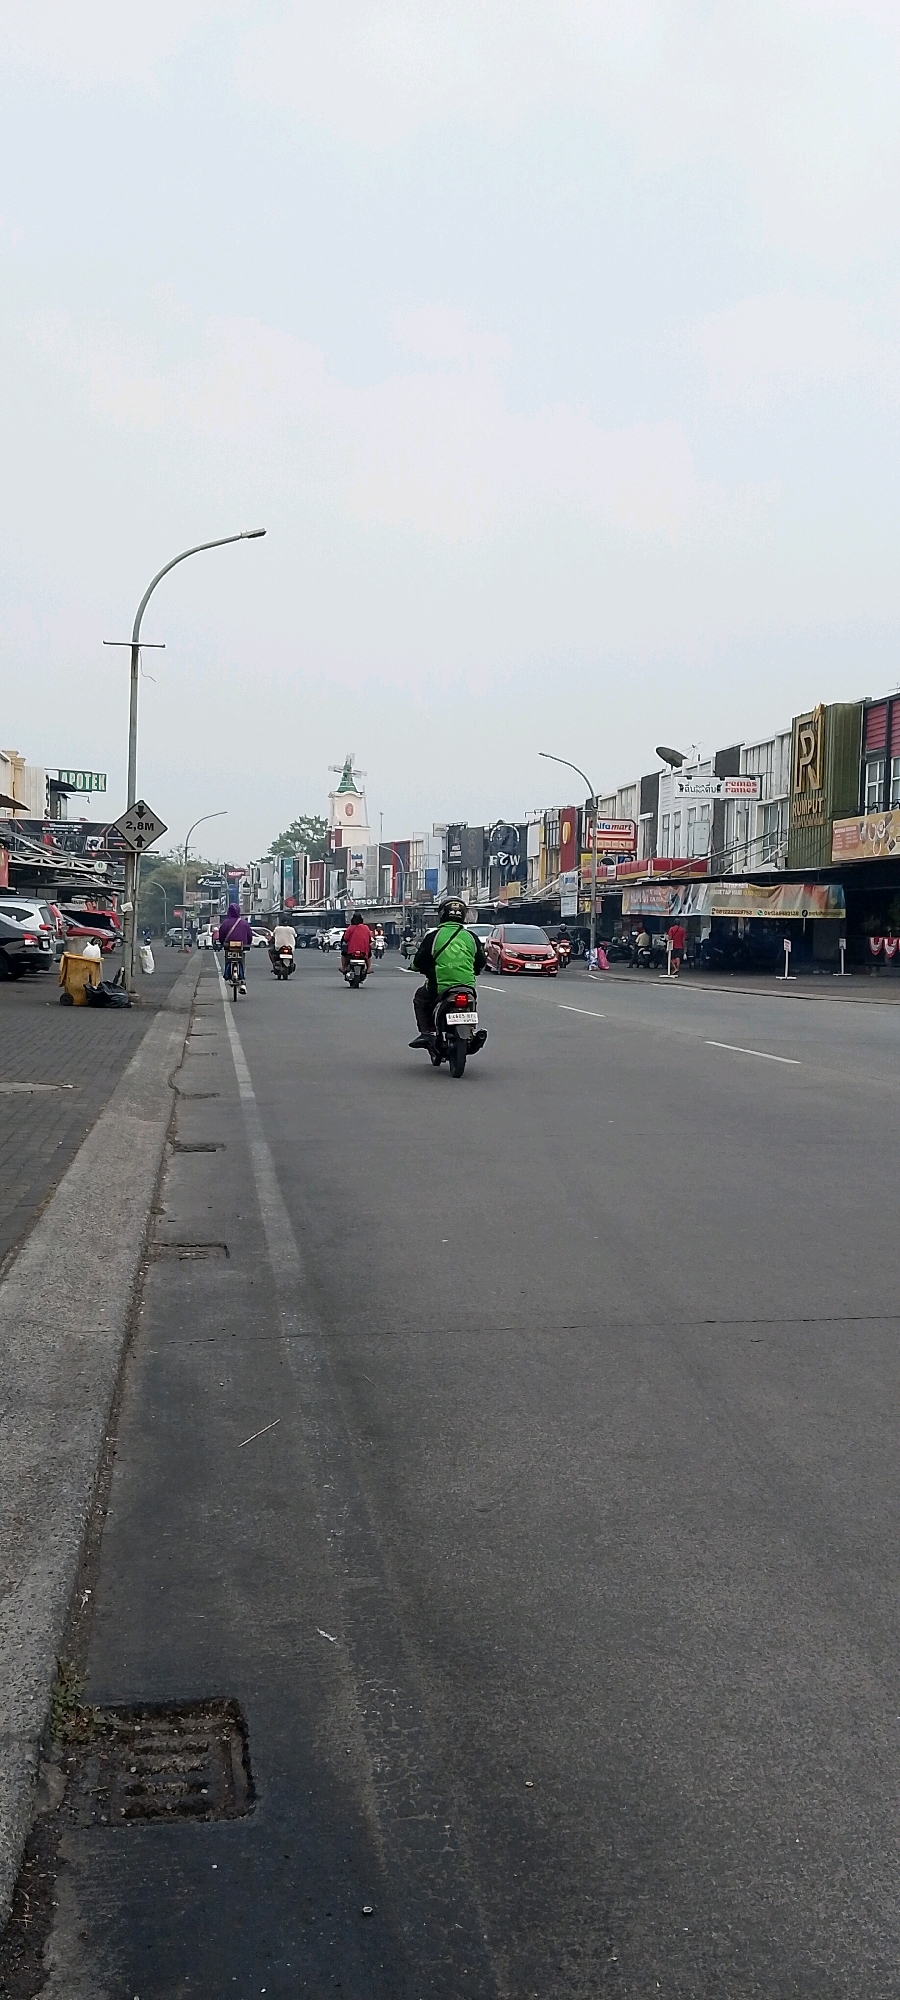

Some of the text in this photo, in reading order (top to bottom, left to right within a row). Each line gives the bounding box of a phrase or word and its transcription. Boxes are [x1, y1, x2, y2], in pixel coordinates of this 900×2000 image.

[61, 772, 106, 791] APOTEK
[793, 797, 824, 817] RUMPUT
[126, 821, 155, 832] 2,8M
